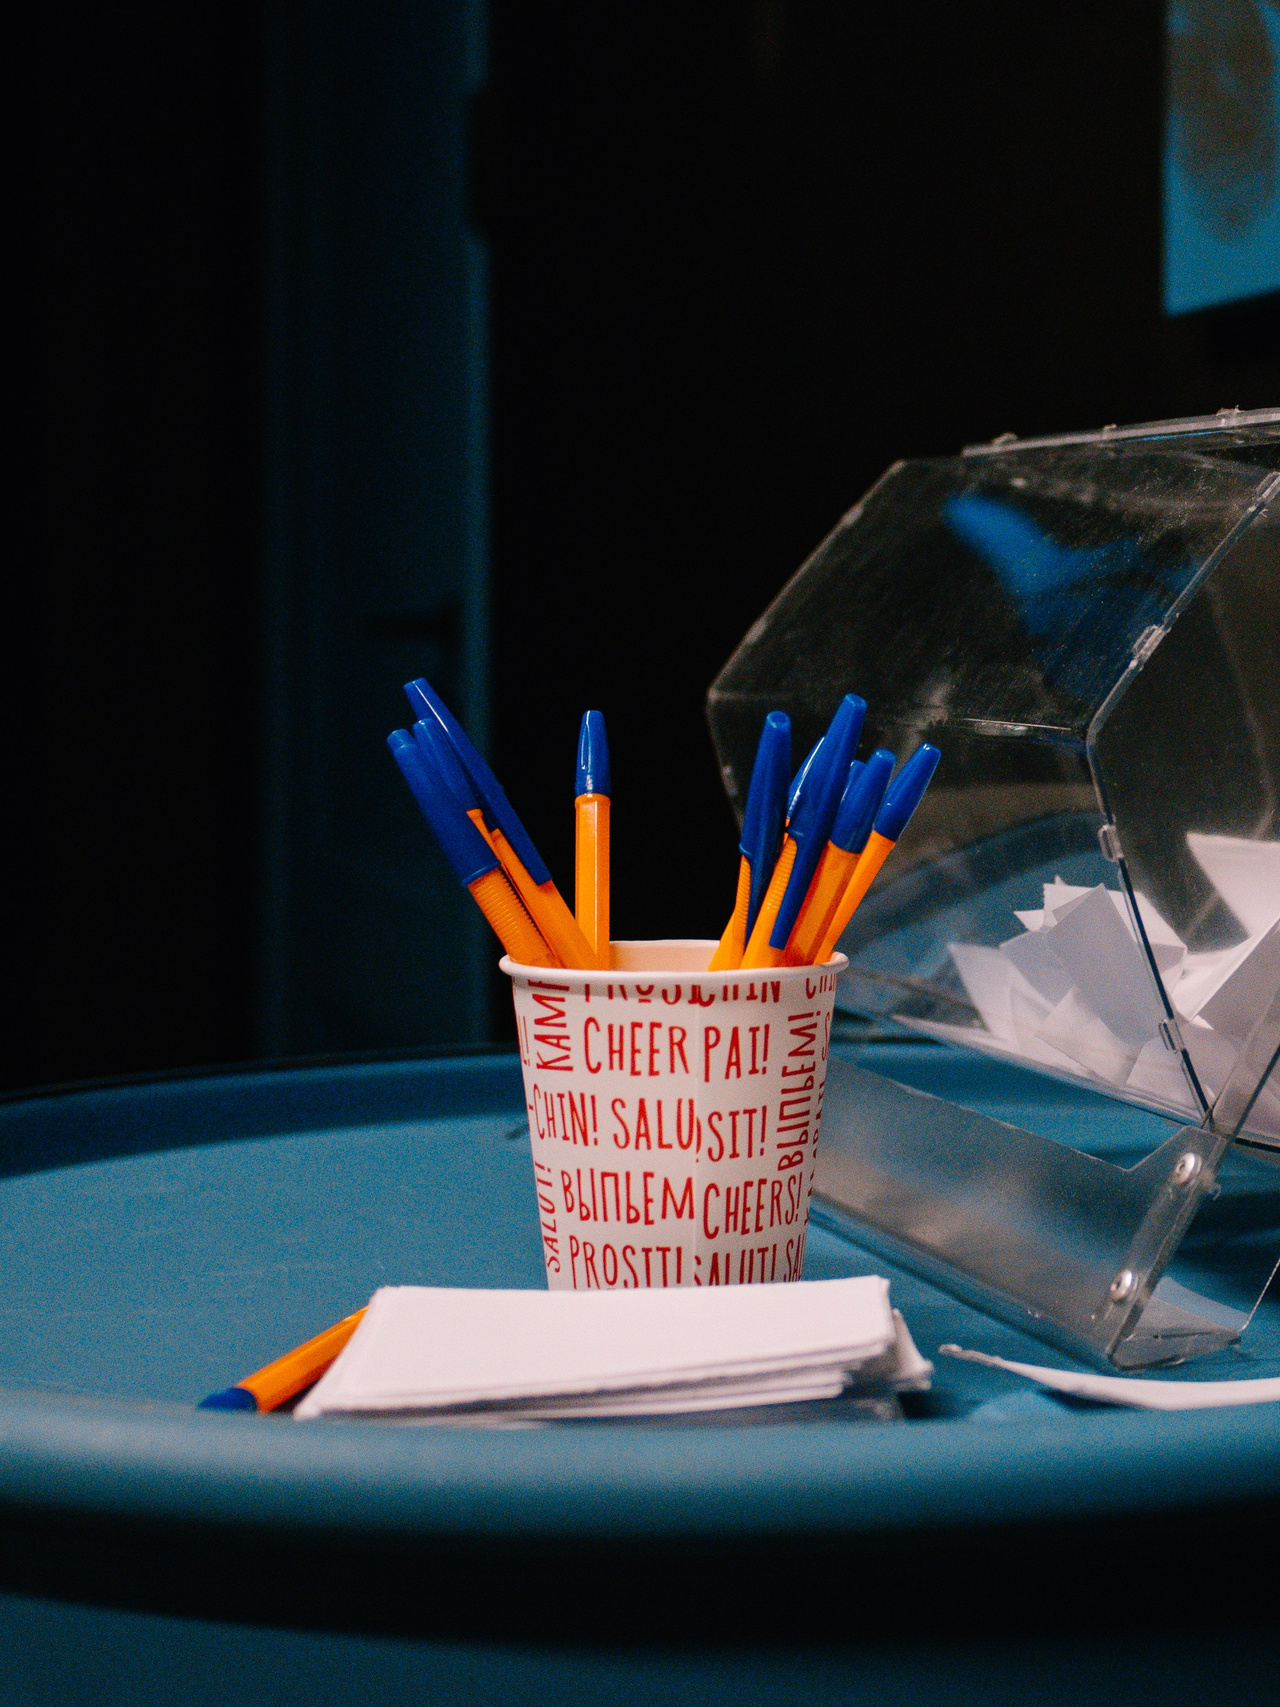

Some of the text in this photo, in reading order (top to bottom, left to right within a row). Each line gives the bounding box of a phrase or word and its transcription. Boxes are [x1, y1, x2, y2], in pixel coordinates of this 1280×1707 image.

[583, 1016, 690, 1077] CHEER
[704, 1023, 770, 1083] PAI!
[776, 1011, 821, 1171] ВЫПЬЕМ!
[611, 1098, 694, 1151] SALU
[696, 1105, 767, 1163] SIT!
[561, 1168, 695, 1226] ВЫПЬЕМ
[703, 1173, 802, 1240] CHEERS!
